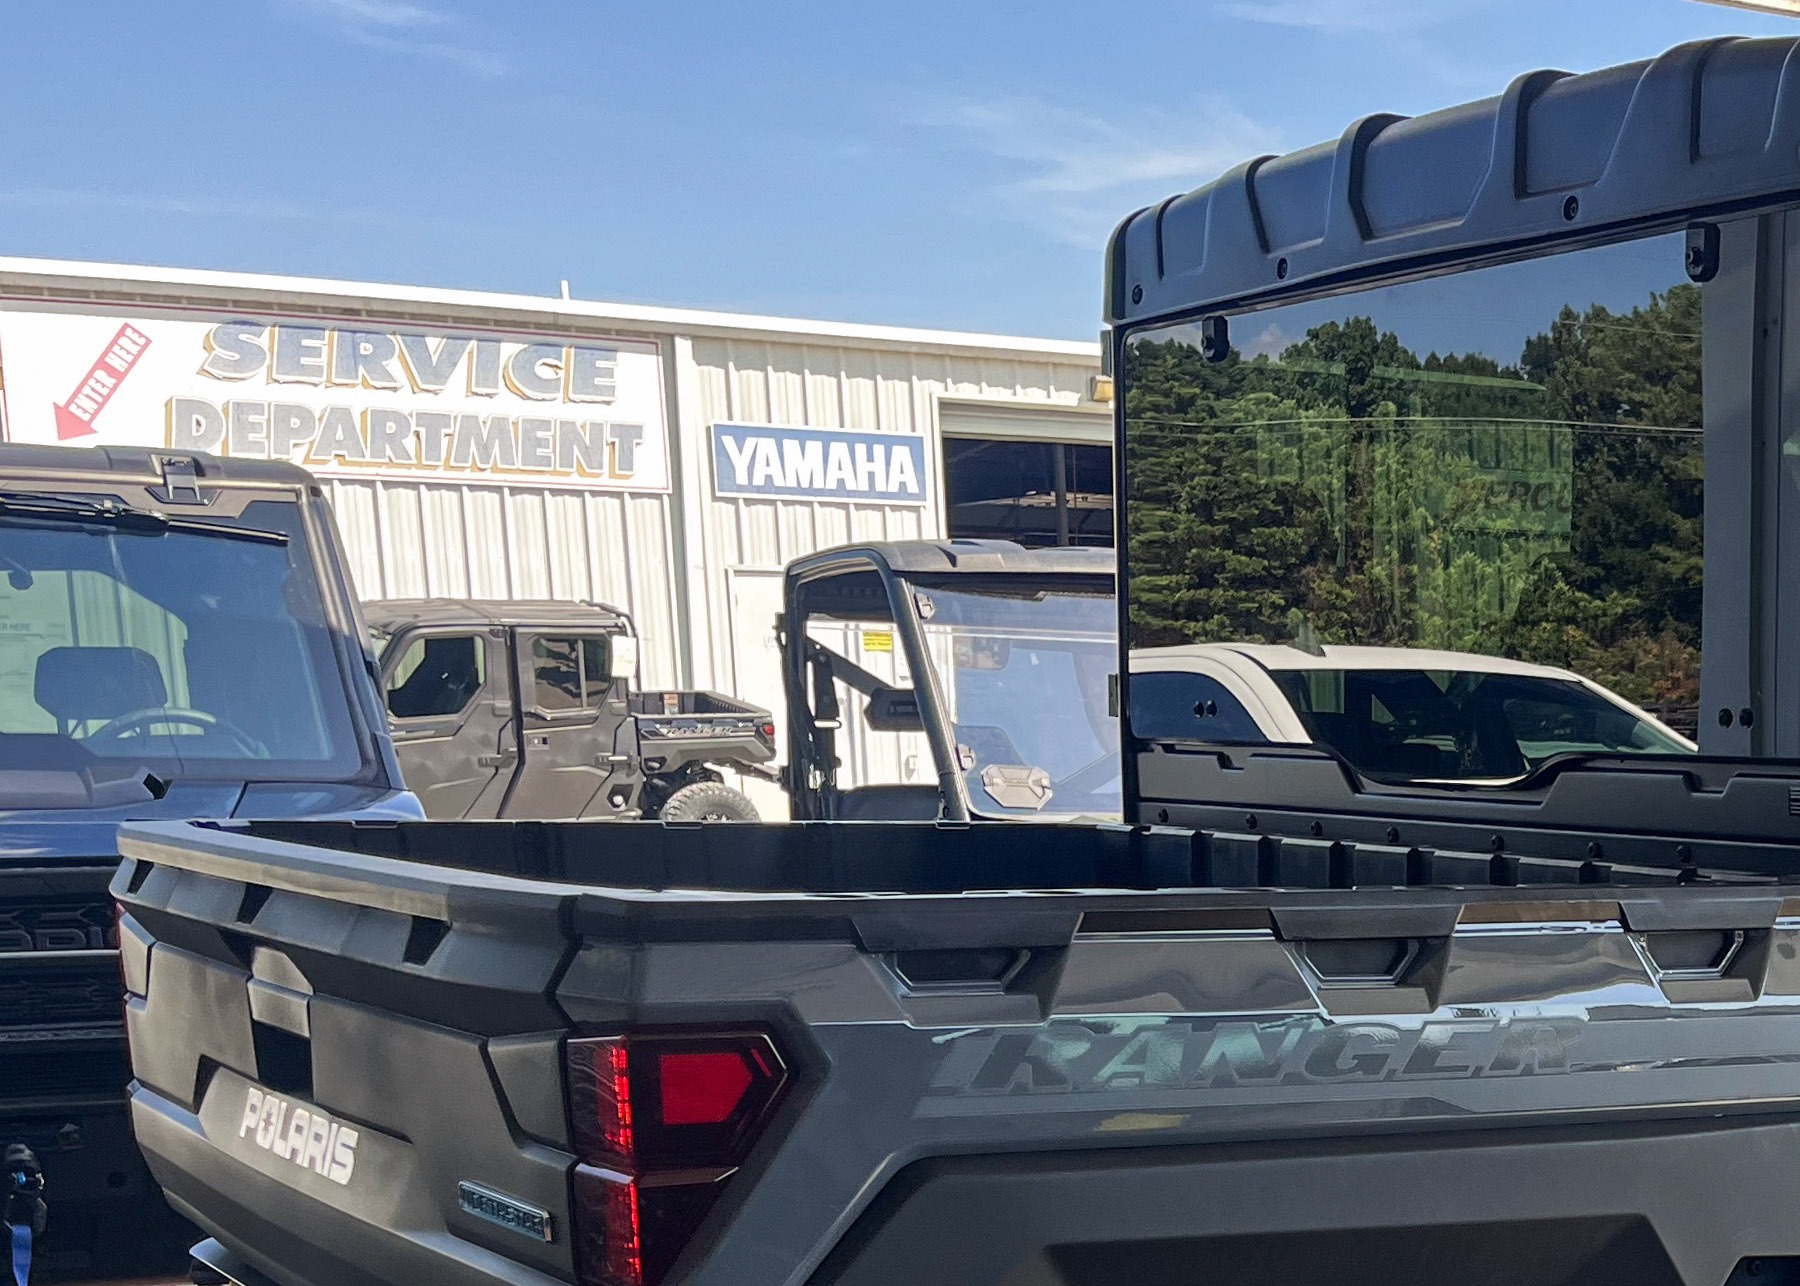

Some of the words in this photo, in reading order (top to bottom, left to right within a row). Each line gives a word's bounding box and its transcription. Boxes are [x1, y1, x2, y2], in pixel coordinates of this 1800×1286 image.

[68, 369, 118, 422] ENTER
[103, 327, 148, 373] HERE
[198, 320, 619, 403] SERVICE
[165, 395, 645, 479] DEPARTMENT
[720, 435, 920, 494] YAMAHA
[963, 1017, 1590, 1096] RANGER
[239, 1087, 359, 1186] POLARIS
